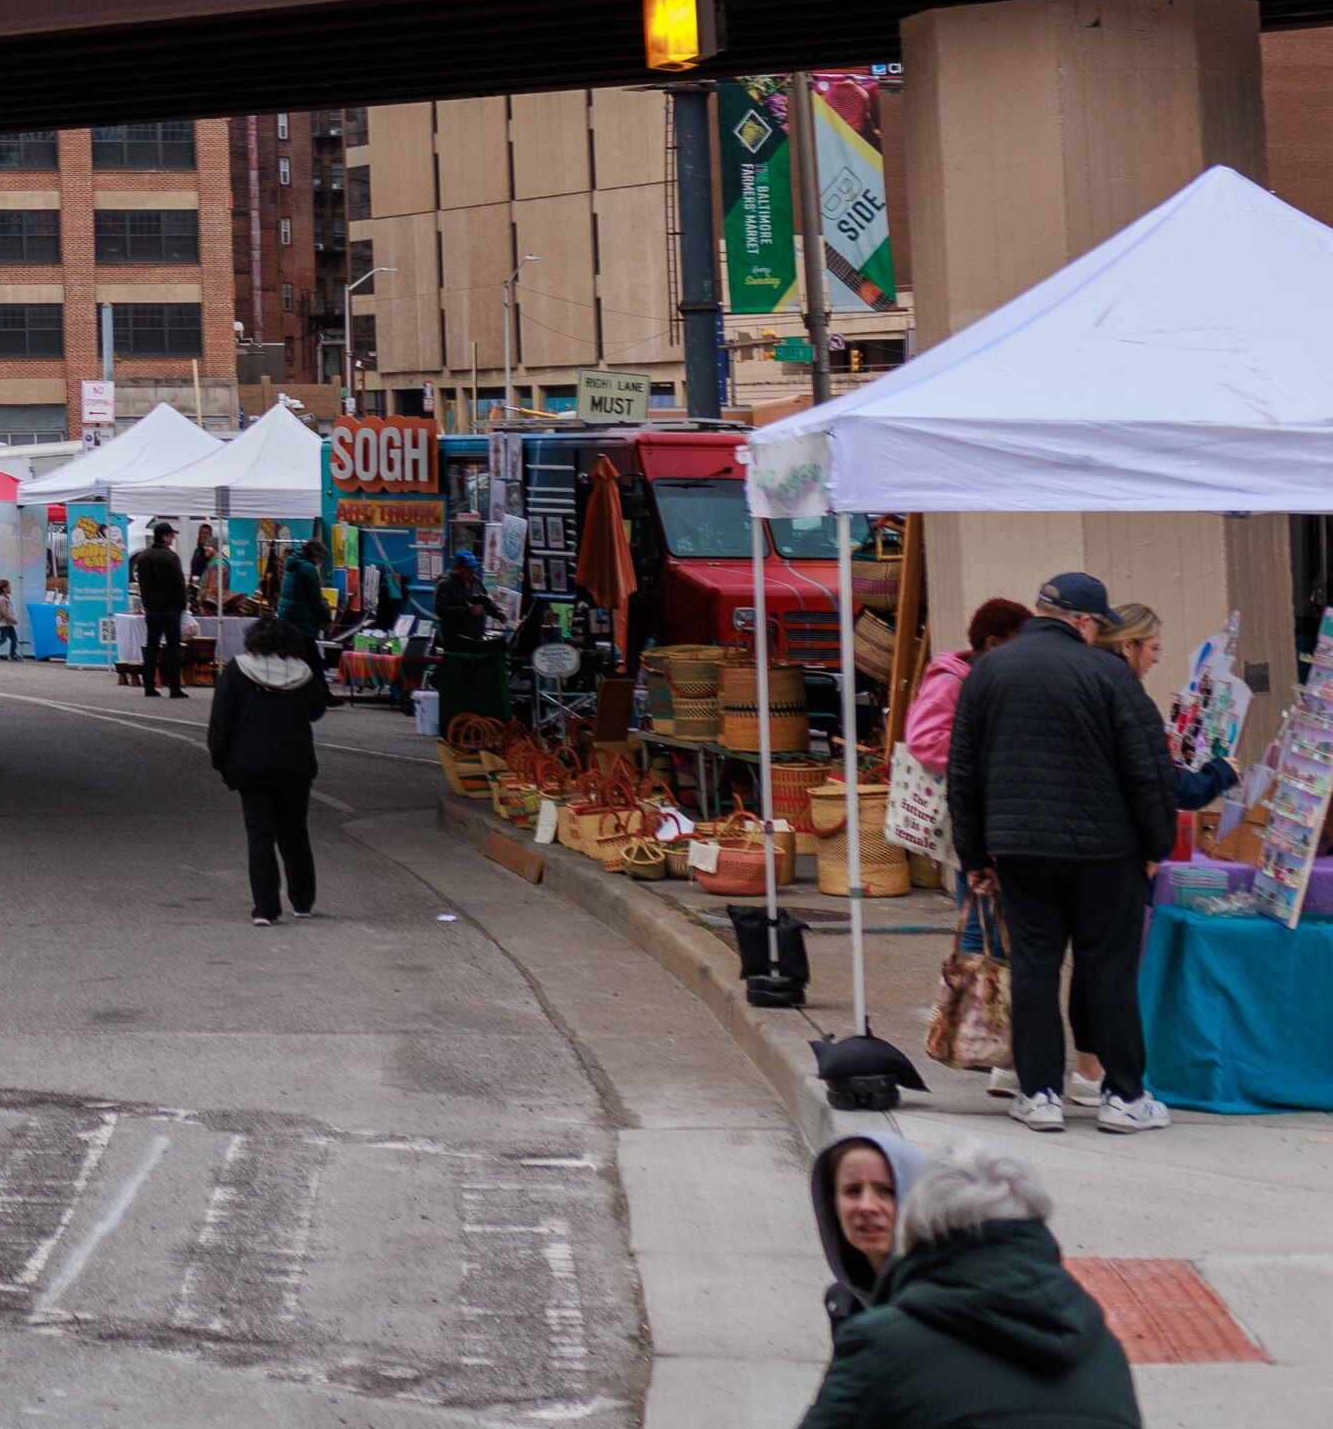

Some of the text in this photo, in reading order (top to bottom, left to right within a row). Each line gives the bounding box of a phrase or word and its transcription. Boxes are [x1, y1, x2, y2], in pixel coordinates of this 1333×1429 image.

[740, 164, 759, 255] FARMERS' MARKET
[756, 162, 773, 245] THE BALTIMORE
[837, 188, 886, 242] SIDE
[744, 275, 781, 289] Sunday
[93, 386, 104, 395] NO
[586, 377, 645, 393] RIGHT LANE
[590, 395, 634, 416] MUST
[331, 426, 429, 483] SOGH
[337, 503, 369, 522] ART
[377, 504, 440, 523] TRUCK
[912, 792, 930, 809] the
[900, 798, 938, 825] future
[910, 817, 921, 832] is
[894, 824, 938, 851] female
